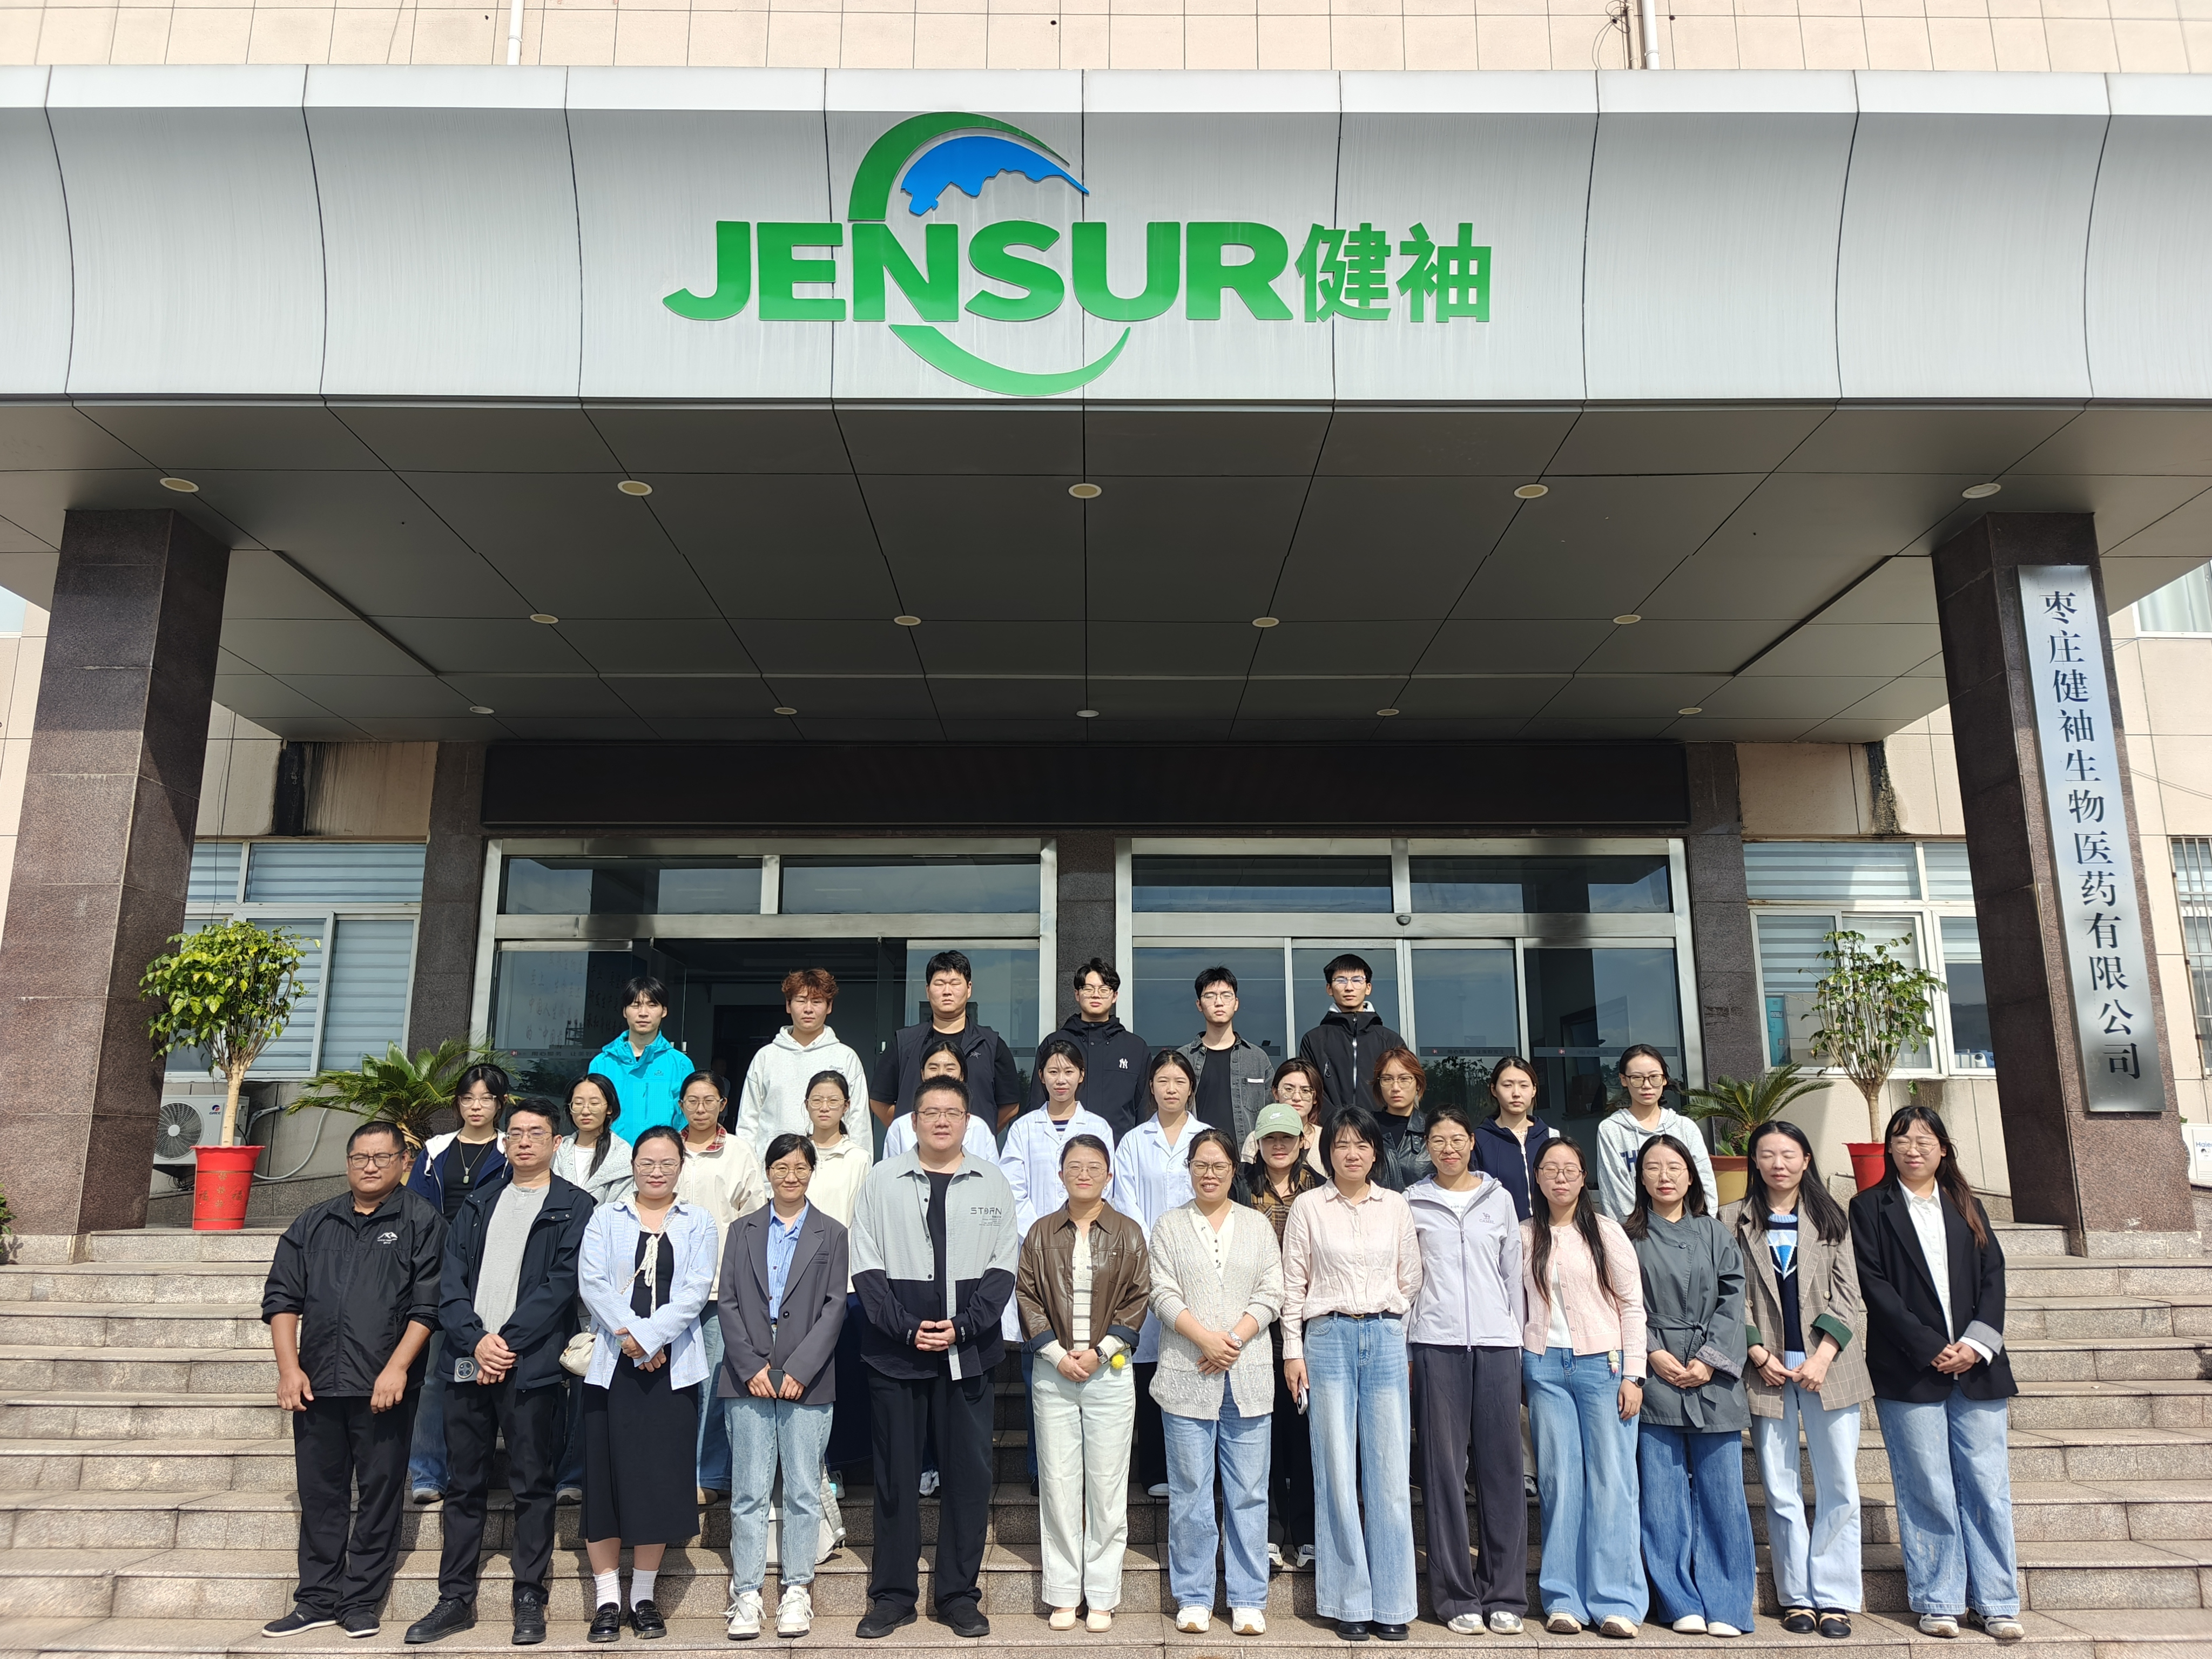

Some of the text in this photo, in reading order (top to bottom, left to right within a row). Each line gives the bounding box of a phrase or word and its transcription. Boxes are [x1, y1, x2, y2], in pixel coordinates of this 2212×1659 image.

[663, 220, 1492, 323] JENSUR 健袖
[2039, 591, 2142, 1081] 枣庄健袖生物医药有限公司
